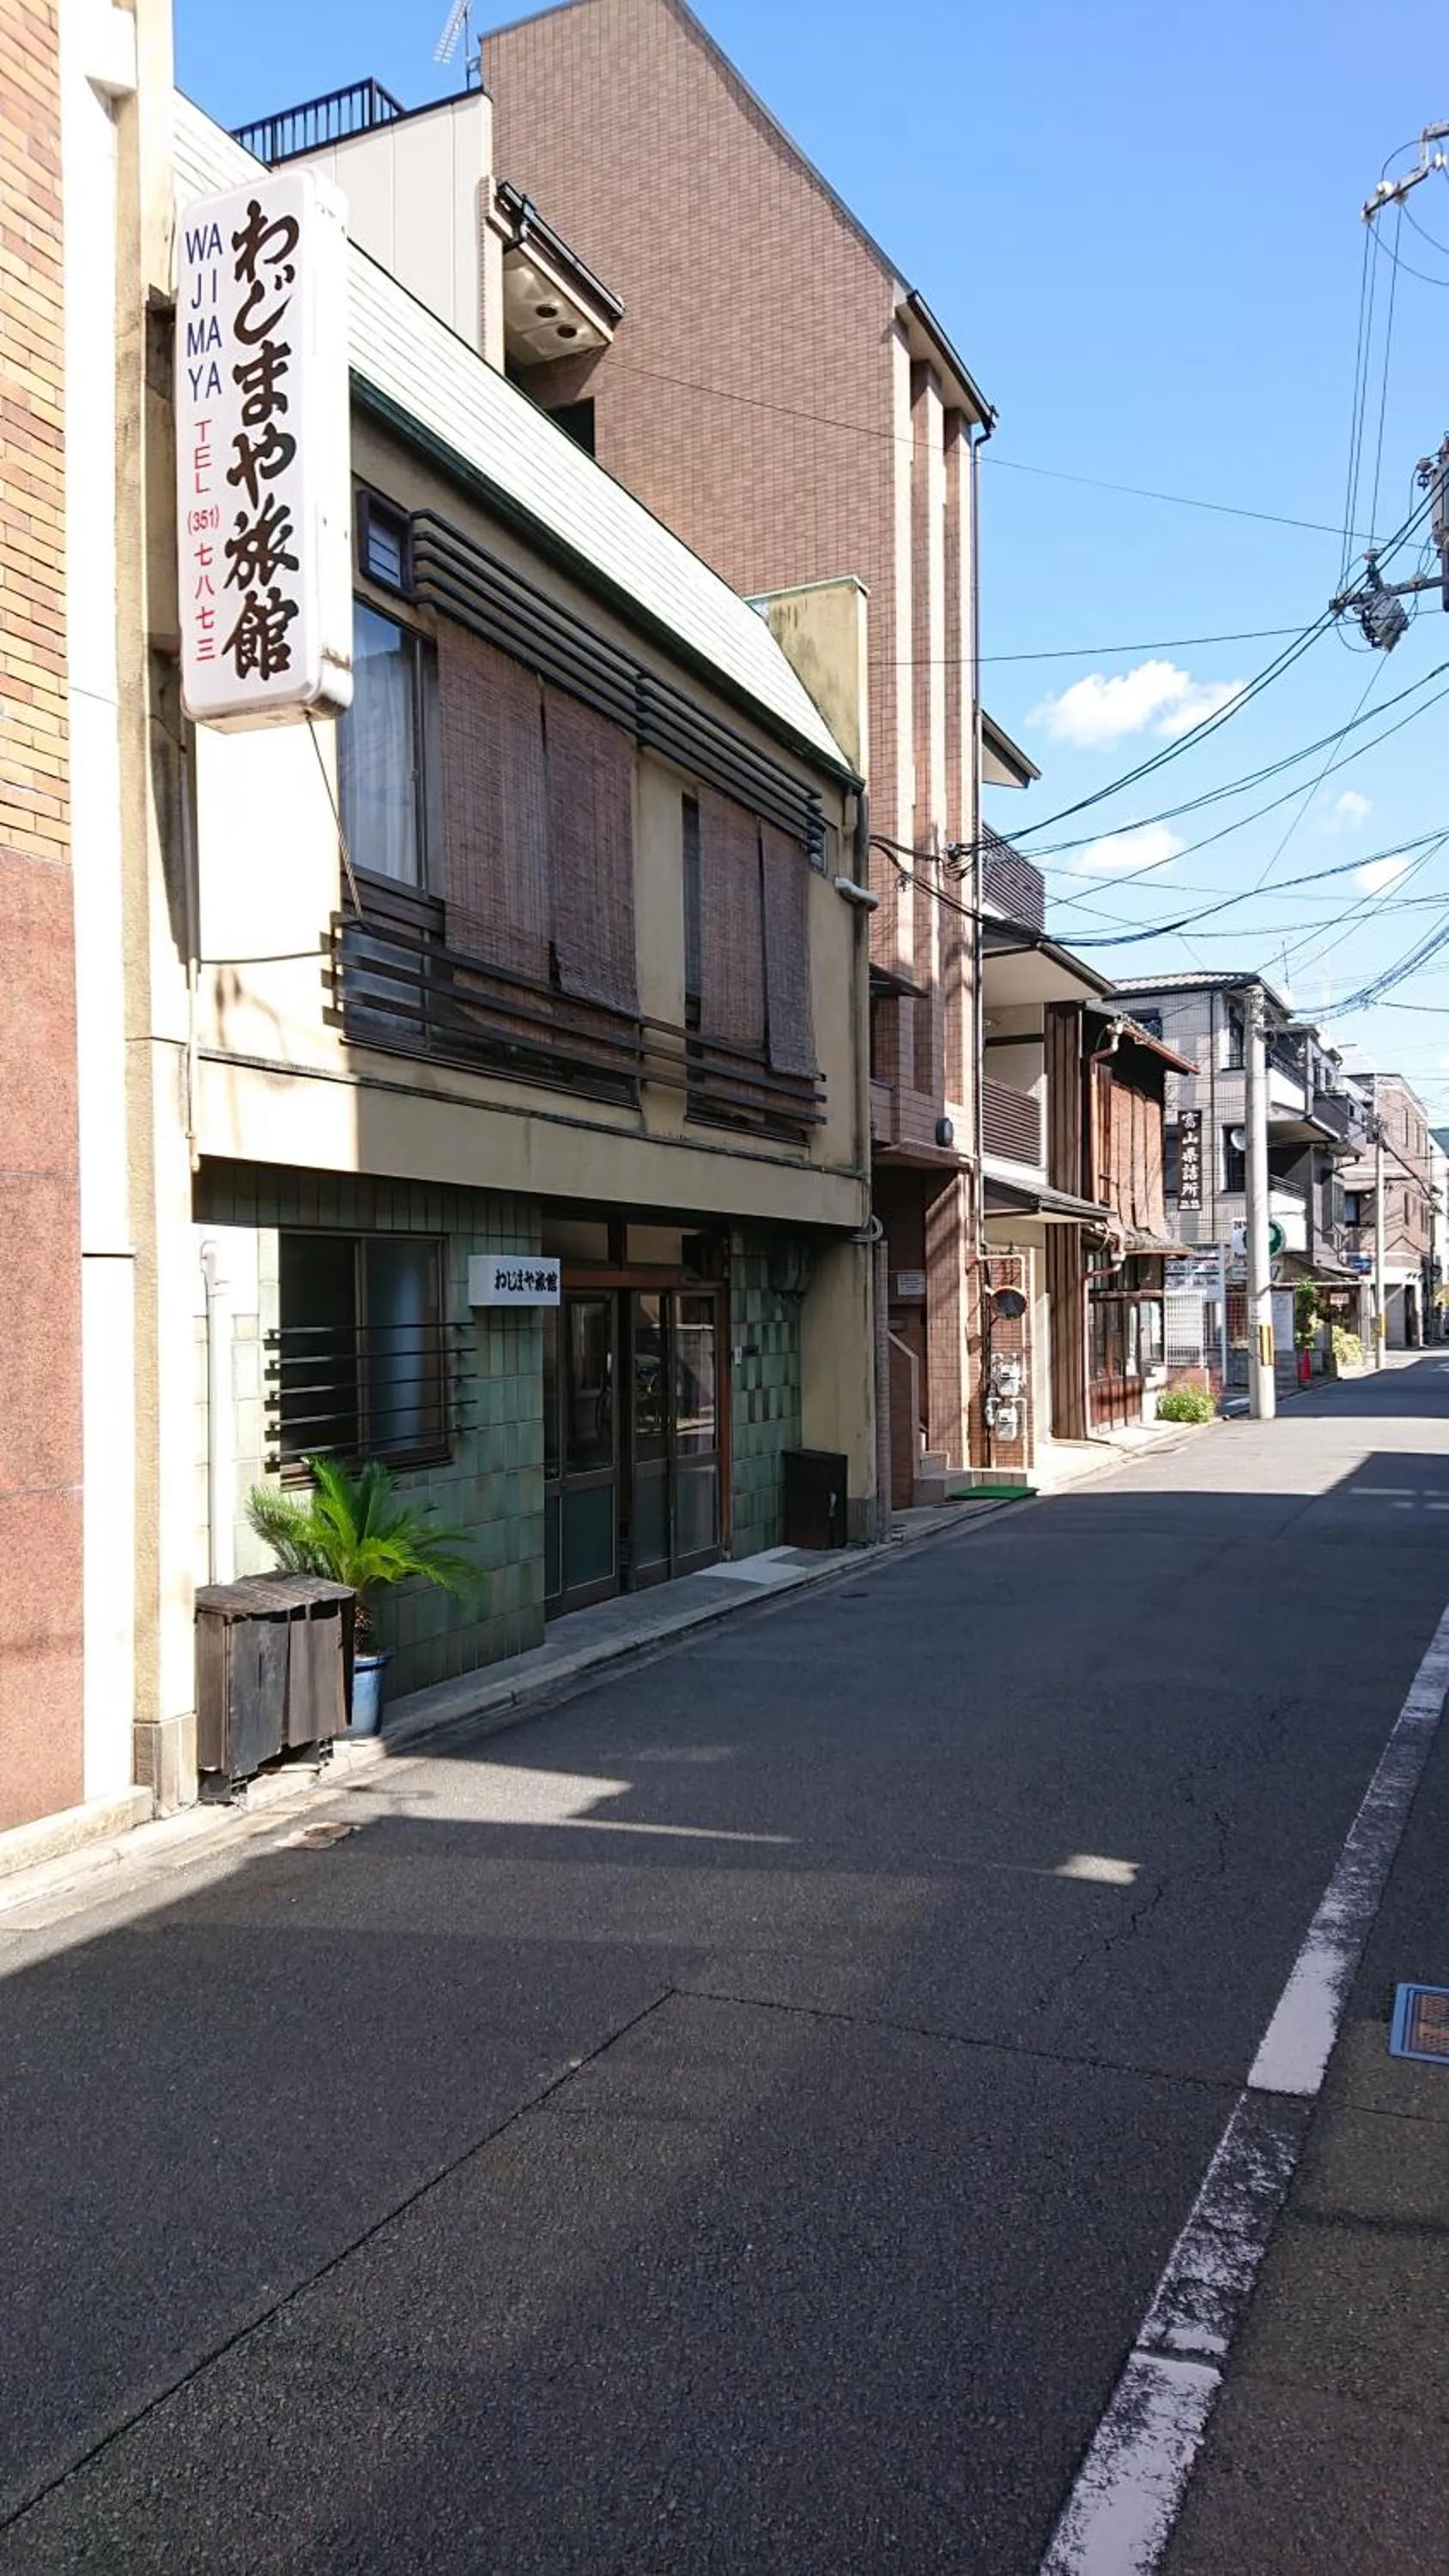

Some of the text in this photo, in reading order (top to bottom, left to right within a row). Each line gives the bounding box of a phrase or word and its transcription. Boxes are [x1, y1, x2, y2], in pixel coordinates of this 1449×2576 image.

[185, 222, 223, 264] WA
[191, 268, 217, 309] JI
[186, 315, 222, 357] MA
[188, 361, 222, 402] YA
[221, 199, 300, 681] わじまや旅館
[187, 419, 220, 661] TEL (351) 七八七三
